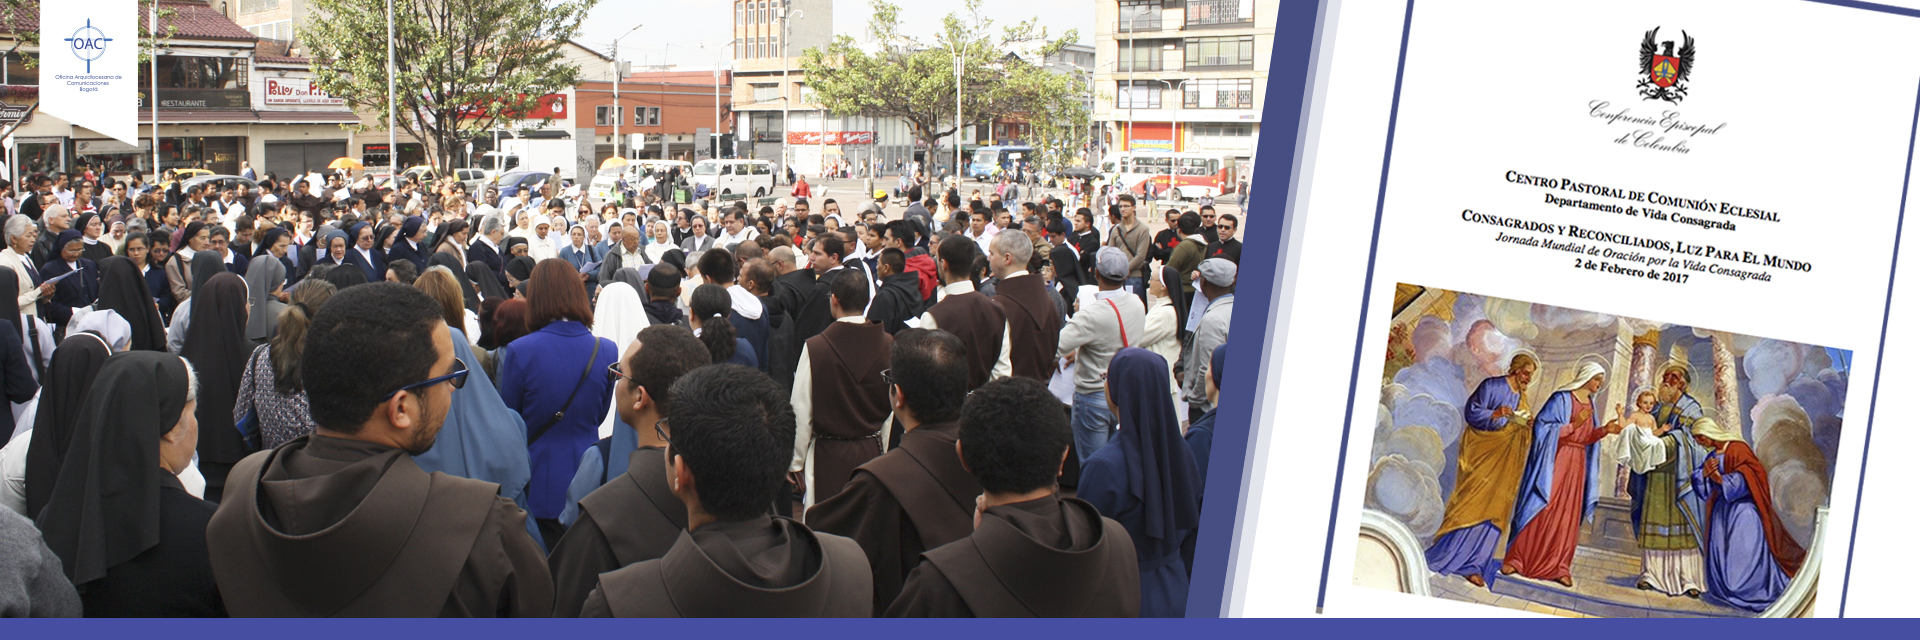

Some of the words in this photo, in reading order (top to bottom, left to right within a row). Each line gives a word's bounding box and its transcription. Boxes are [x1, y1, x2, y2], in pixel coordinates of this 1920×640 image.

[1588, 100, 1657, 125] Conferencia
[1659, 110, 1728, 138] Episcopal
[1614, 132, 1630, 145] de
[1632, 130, 1690, 154] Colombia
[1506, 170, 1558, 188] CENTRO
[1560, 178, 1626, 199] PASTORAL
[1628, 190, 1645, 202] DE
[1648, 192, 1718, 212] COMUNIÓN
[1719, 202, 1780, 222] ECLESIAL
[1544, 193, 1624, 214] Departamento
[1625, 206, 1638, 216] de
[1642, 208, 1668, 221] Vida
[1670, 212, 1736, 231] Consagrada
[1462, 209, 1554, 234] CONSAGRADOS
[1568, 224, 1674, 254] RECONCILIADOS,
[1676, 241, 1704, 256] LUZ
[1705, 246, 1740, 262] PARA
[1742, 251, 1760, 264] EL
[1762, 254, 1812, 272] MUNDO
[1495, 232, 1539, 246] Jornada
[1540, 238, 1586, 254] Mundial
[1587, 246, 1600, 256] de
[1602, 248, 1646, 263] Oración
[1647, 256, 1666, 266] por
[1668, 258, 1680, 268] la
[1683, 259, 1706, 272] Vida
[1708, 264, 1772, 282] Consagrada
[1574, 258, 1582, 268] 2
[1584, 260, 1598, 270] de
[1600, 261, 1644, 278] Febrero
[1647, 269, 1660, 280] de
[1662, 272, 1689, 284] 2017
